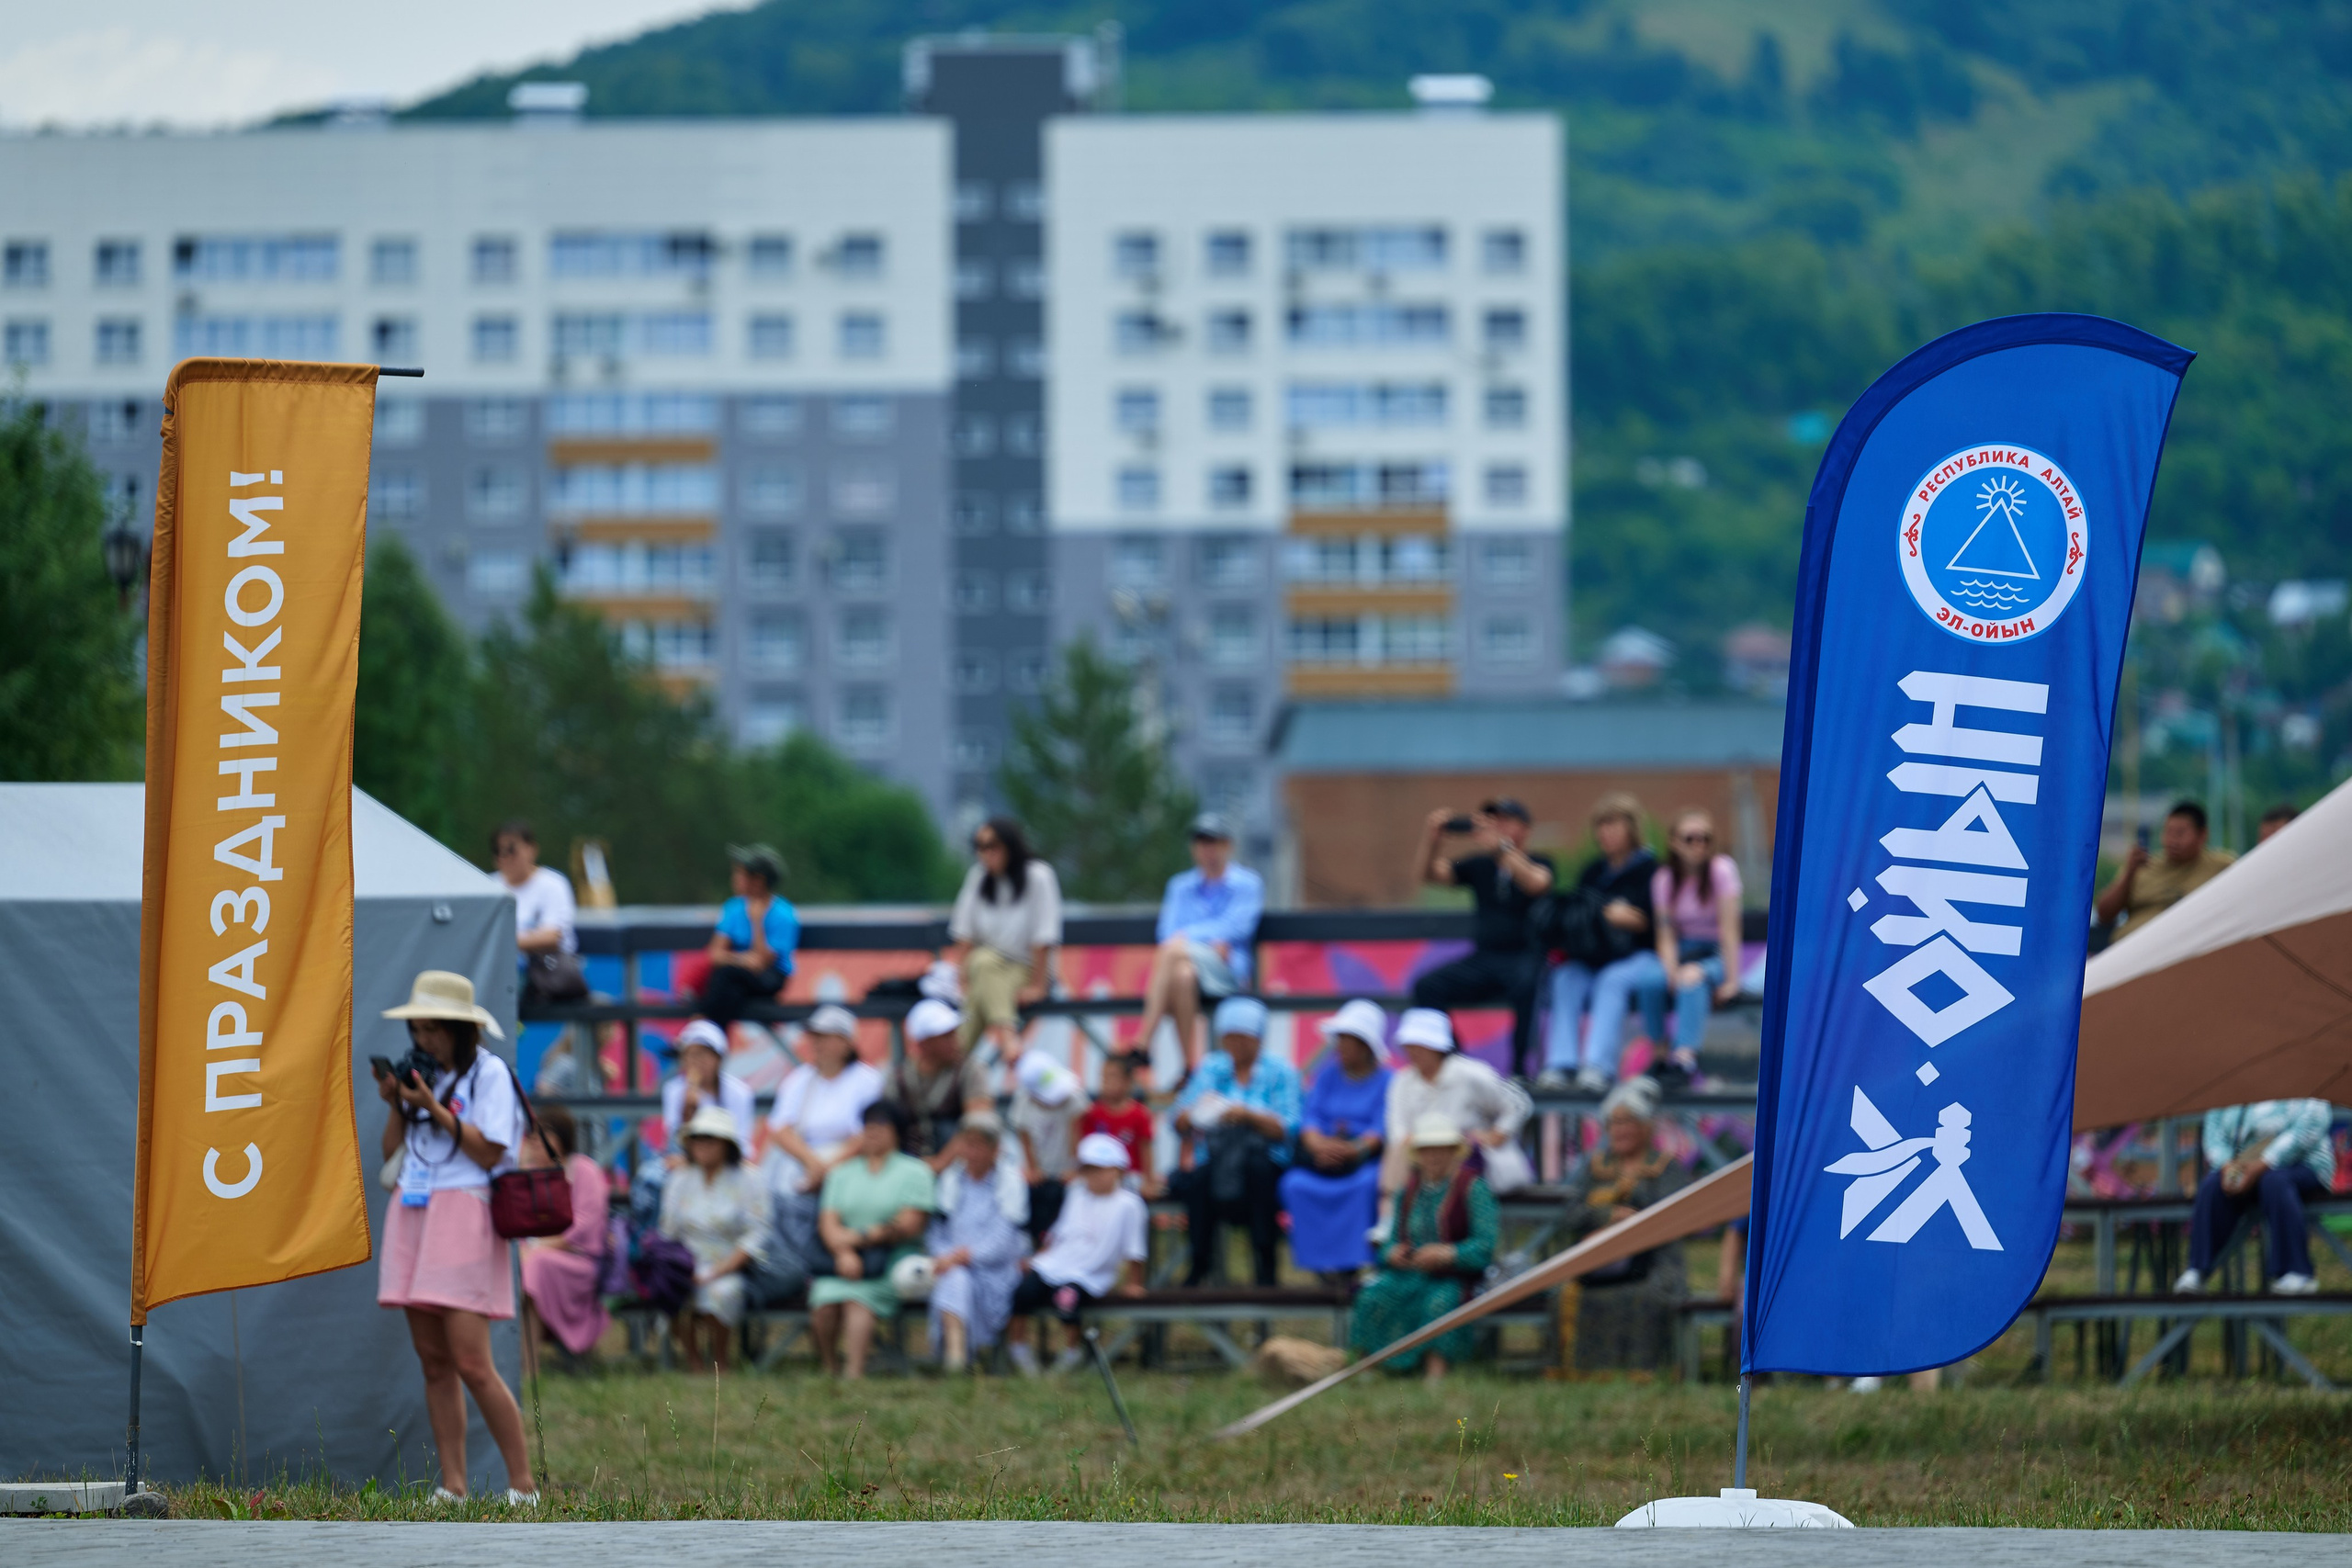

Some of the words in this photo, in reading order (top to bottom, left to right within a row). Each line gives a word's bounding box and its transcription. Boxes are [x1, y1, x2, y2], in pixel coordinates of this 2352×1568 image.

[1918, 450, 2030, 502] РЕСПУБЛИКА
[2041, 468, 2083, 520] АЛТАЙ
[1936, 606, 2035, 639] ЭЛ-ОЙЫН
[205, 469, 286, 1113] ПРАЗДНИКОМ!
[203, 1143, 263, 1199] С
